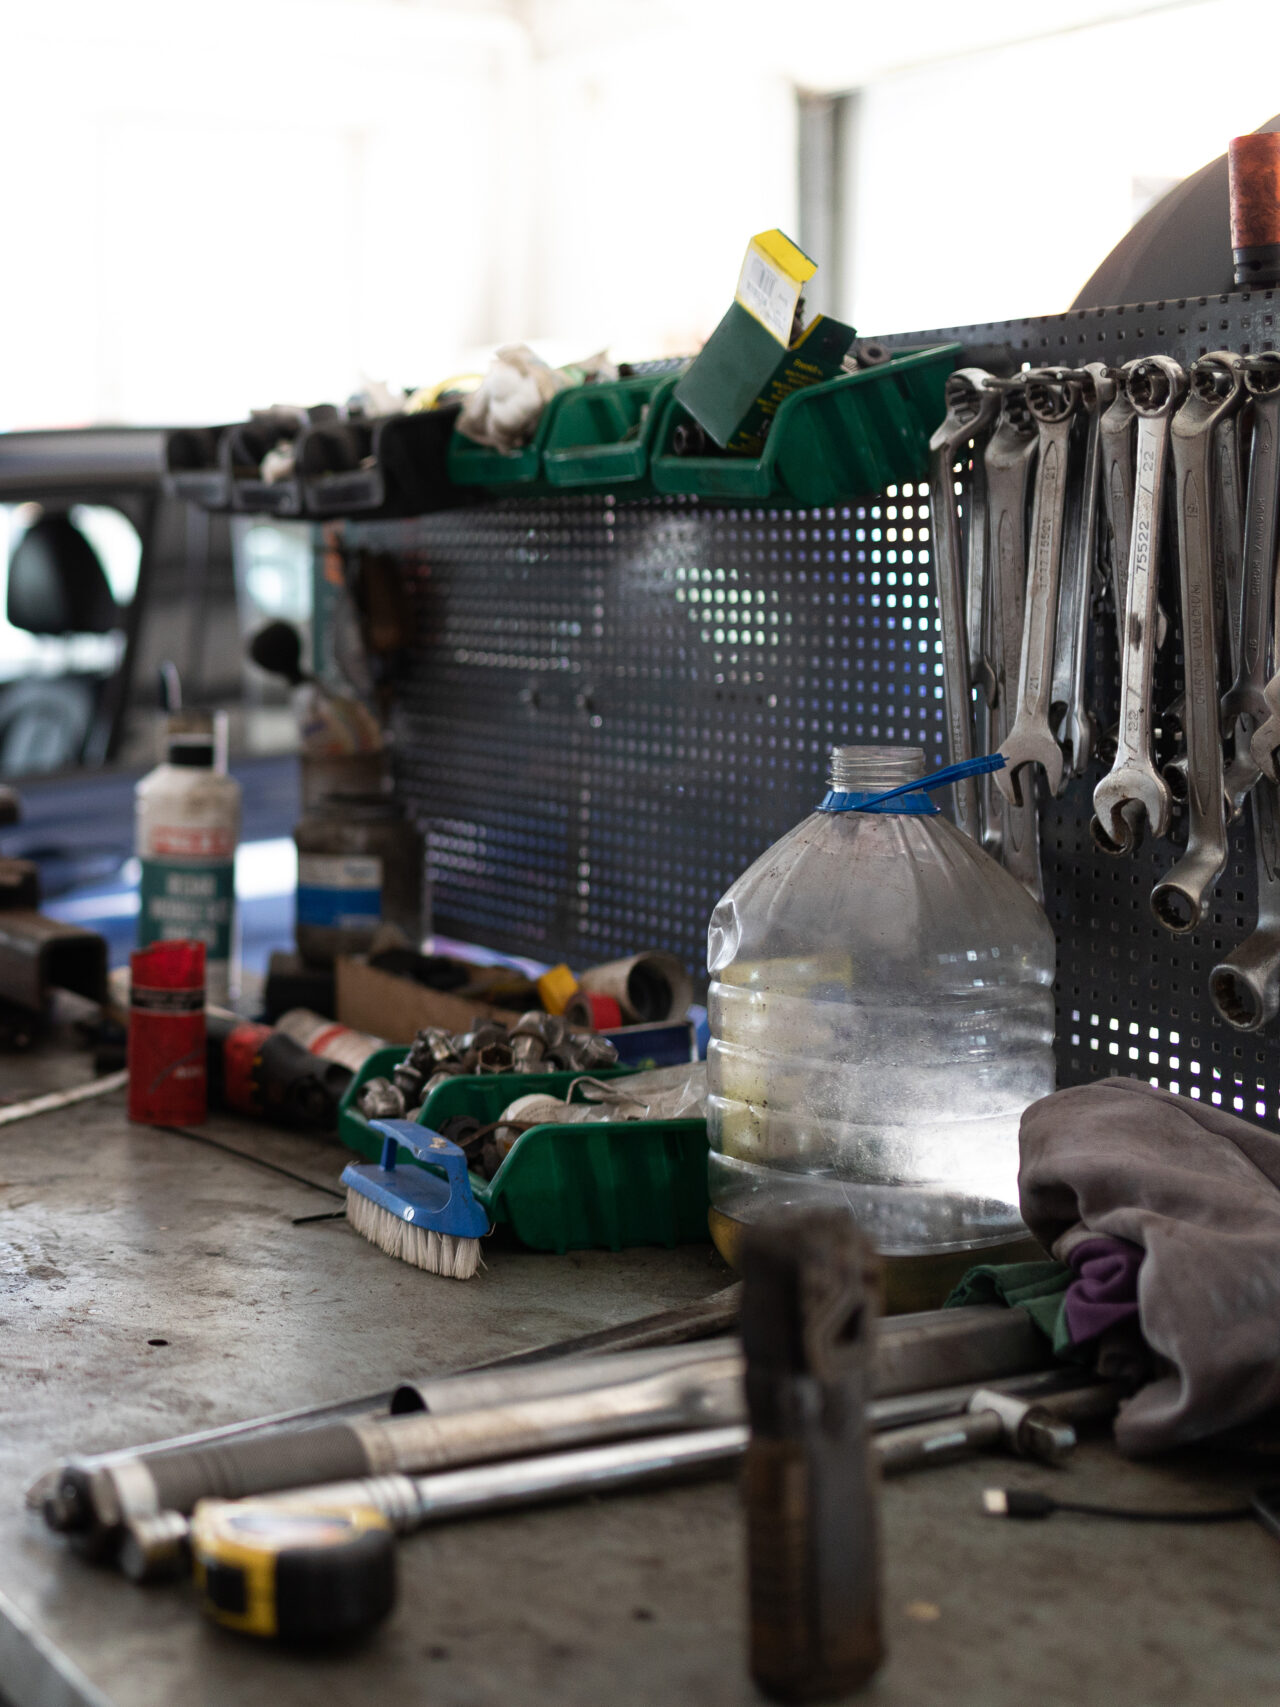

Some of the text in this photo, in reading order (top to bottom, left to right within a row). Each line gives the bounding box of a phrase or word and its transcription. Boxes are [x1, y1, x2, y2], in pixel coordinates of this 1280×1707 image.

[1045, 465, 1055, 481] 21
[1141, 450, 1154, 473] 22
[1134, 520, 1151, 575] 75522
[1189, 583, 1207, 705] CHROM VANADIUM
[1028, 675, 1040, 691] 21
[1127, 709, 1140, 732] 22
